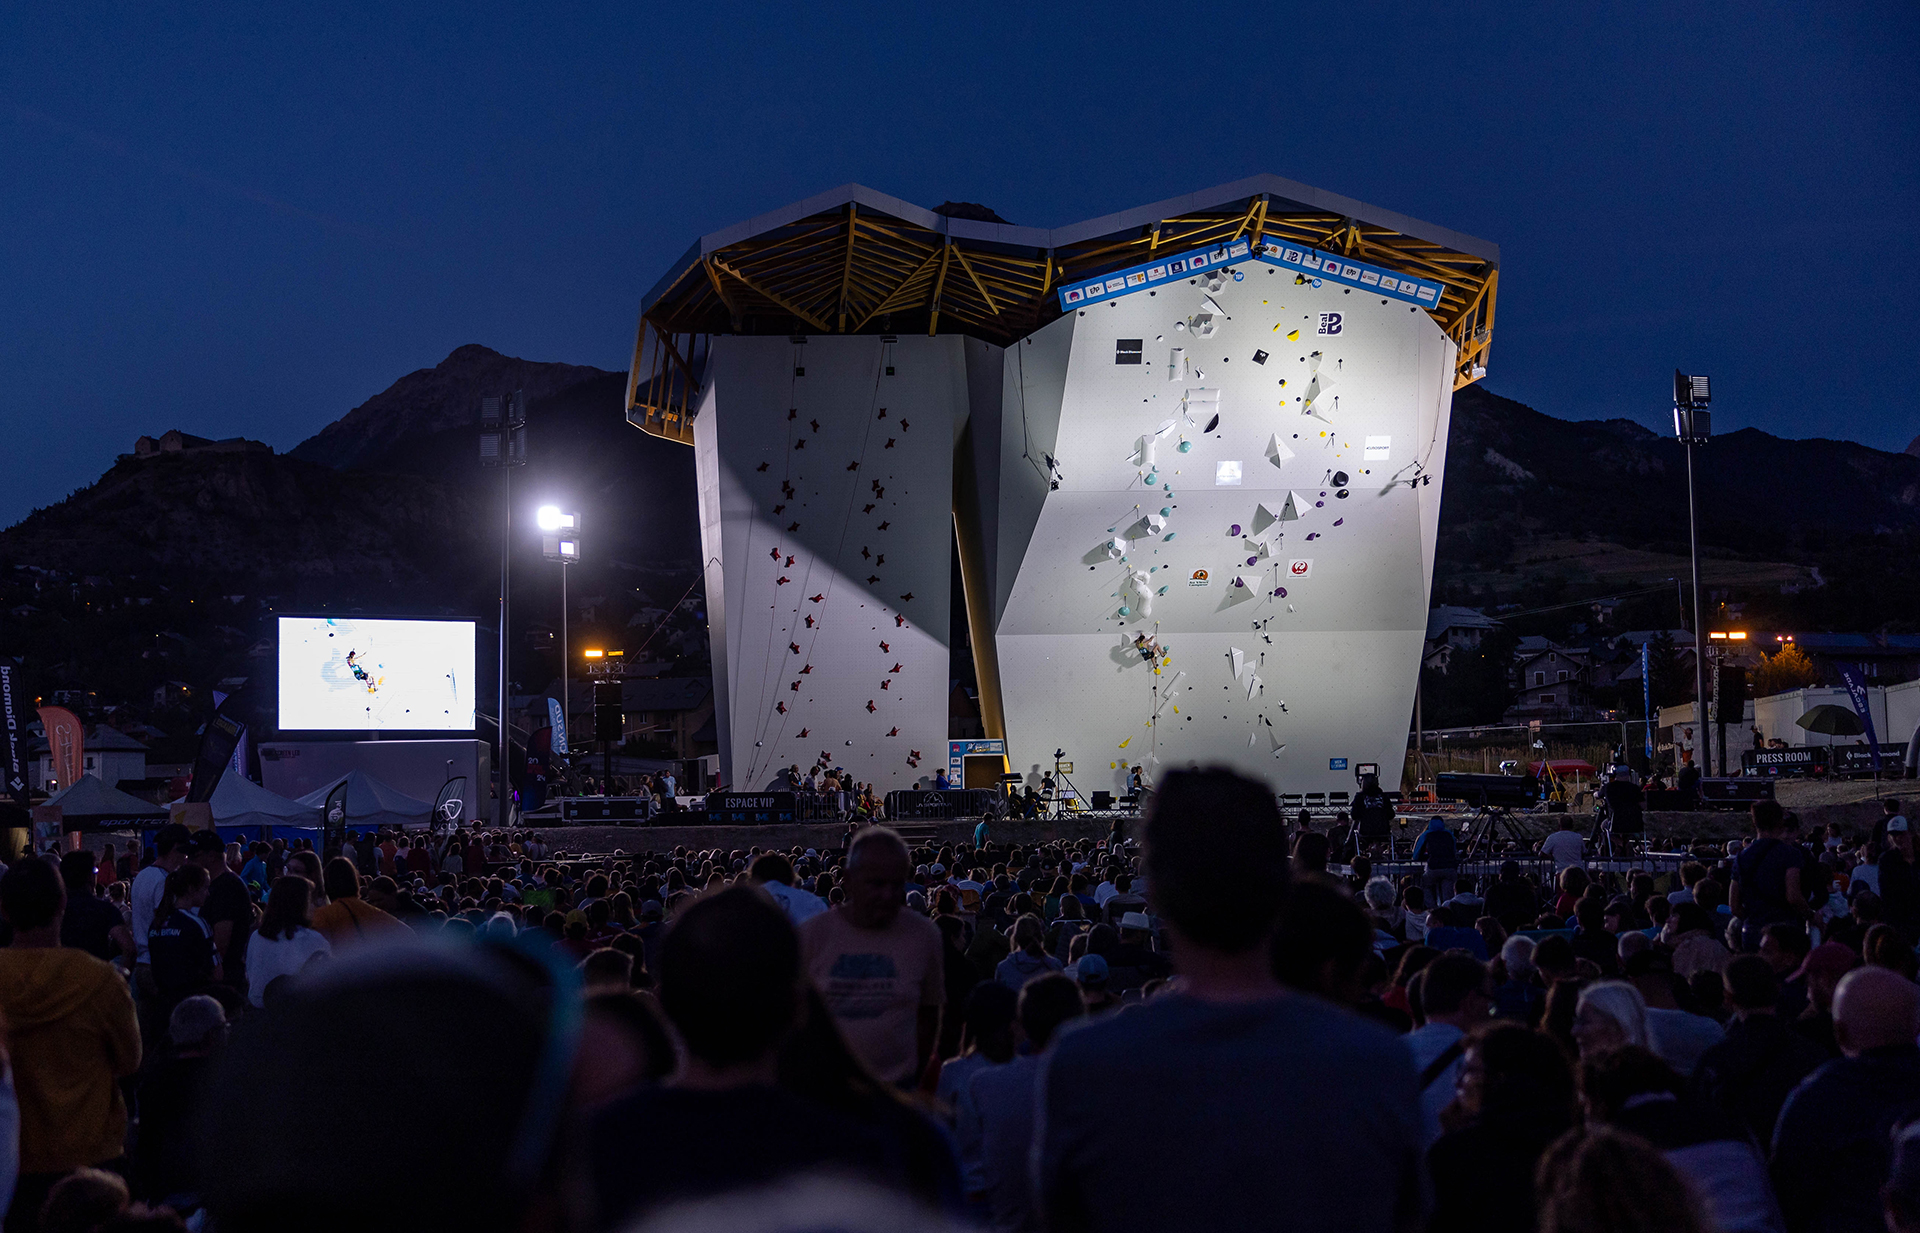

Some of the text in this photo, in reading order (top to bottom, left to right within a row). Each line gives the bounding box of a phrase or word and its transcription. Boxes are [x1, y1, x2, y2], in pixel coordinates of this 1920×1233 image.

[1318, 313, 1328, 334] Beal
[1756, 751, 1811, 763] PRESS ROOM
[725, 797, 775, 808] ESPACE VIP
